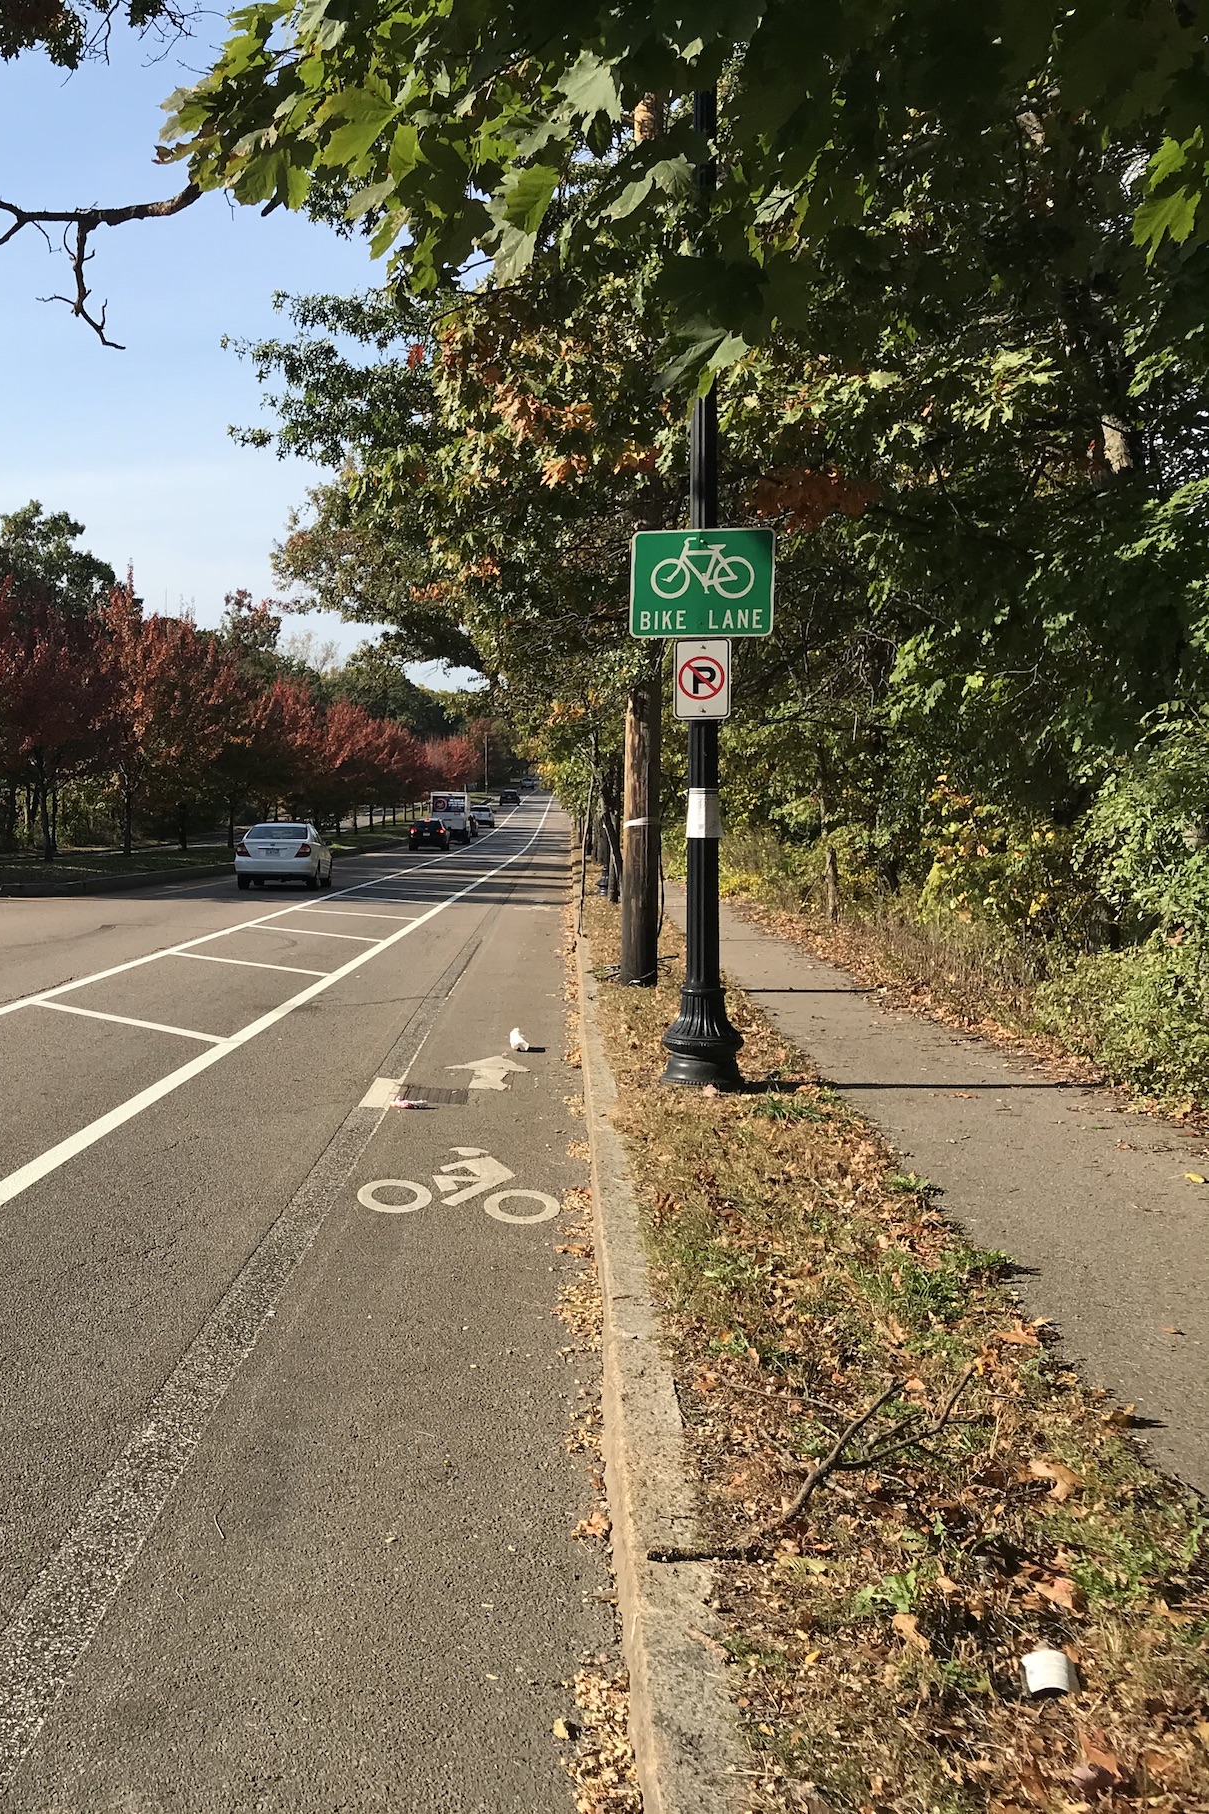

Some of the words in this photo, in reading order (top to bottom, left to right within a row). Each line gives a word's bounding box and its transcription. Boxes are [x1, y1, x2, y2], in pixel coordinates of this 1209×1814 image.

[640, 610, 686, 630] BIKE
[708, 609, 763, 629] LANE
[692, 666, 716, 694] P
